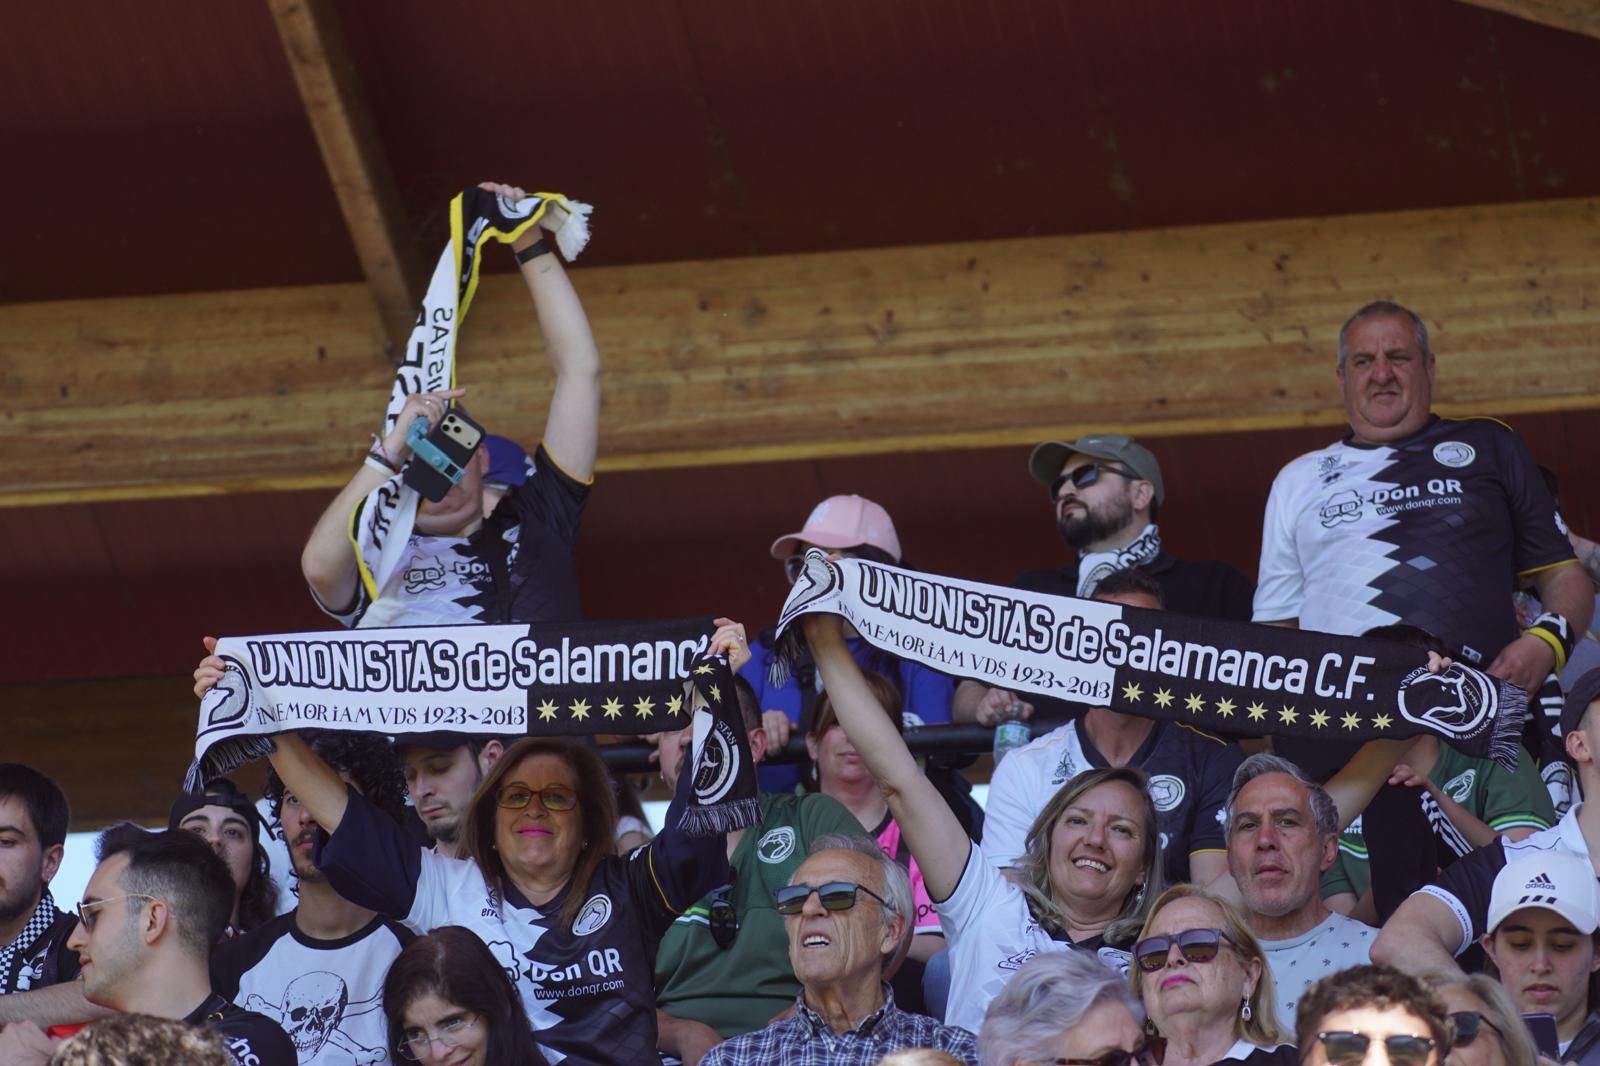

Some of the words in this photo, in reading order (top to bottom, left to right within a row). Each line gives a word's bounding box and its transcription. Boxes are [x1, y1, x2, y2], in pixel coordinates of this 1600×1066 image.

[1373, 485, 1420, 504] Don
[1427, 479, 1463, 495] QR
[1376, 496, 1461, 515] www.donqr.com
[858, 562, 1055, 652] UNIONISTAS
[1057, 614, 1104, 664] de
[1104, 618, 1309, 693] Salamanca
[1314, 652, 1376, 701] C.F.
[247, 639, 460, 692] UNIONISTAS
[463, 643, 511, 692] de
[512, 636, 694, 688] Salamanc
[971, 654, 1008, 678] VDS
[378, 707, 417, 725] VDS
[529, 962, 582, 983] Don
[587, 947, 624, 978] QR
[535, 979, 625, 1000] www.donqr.com
